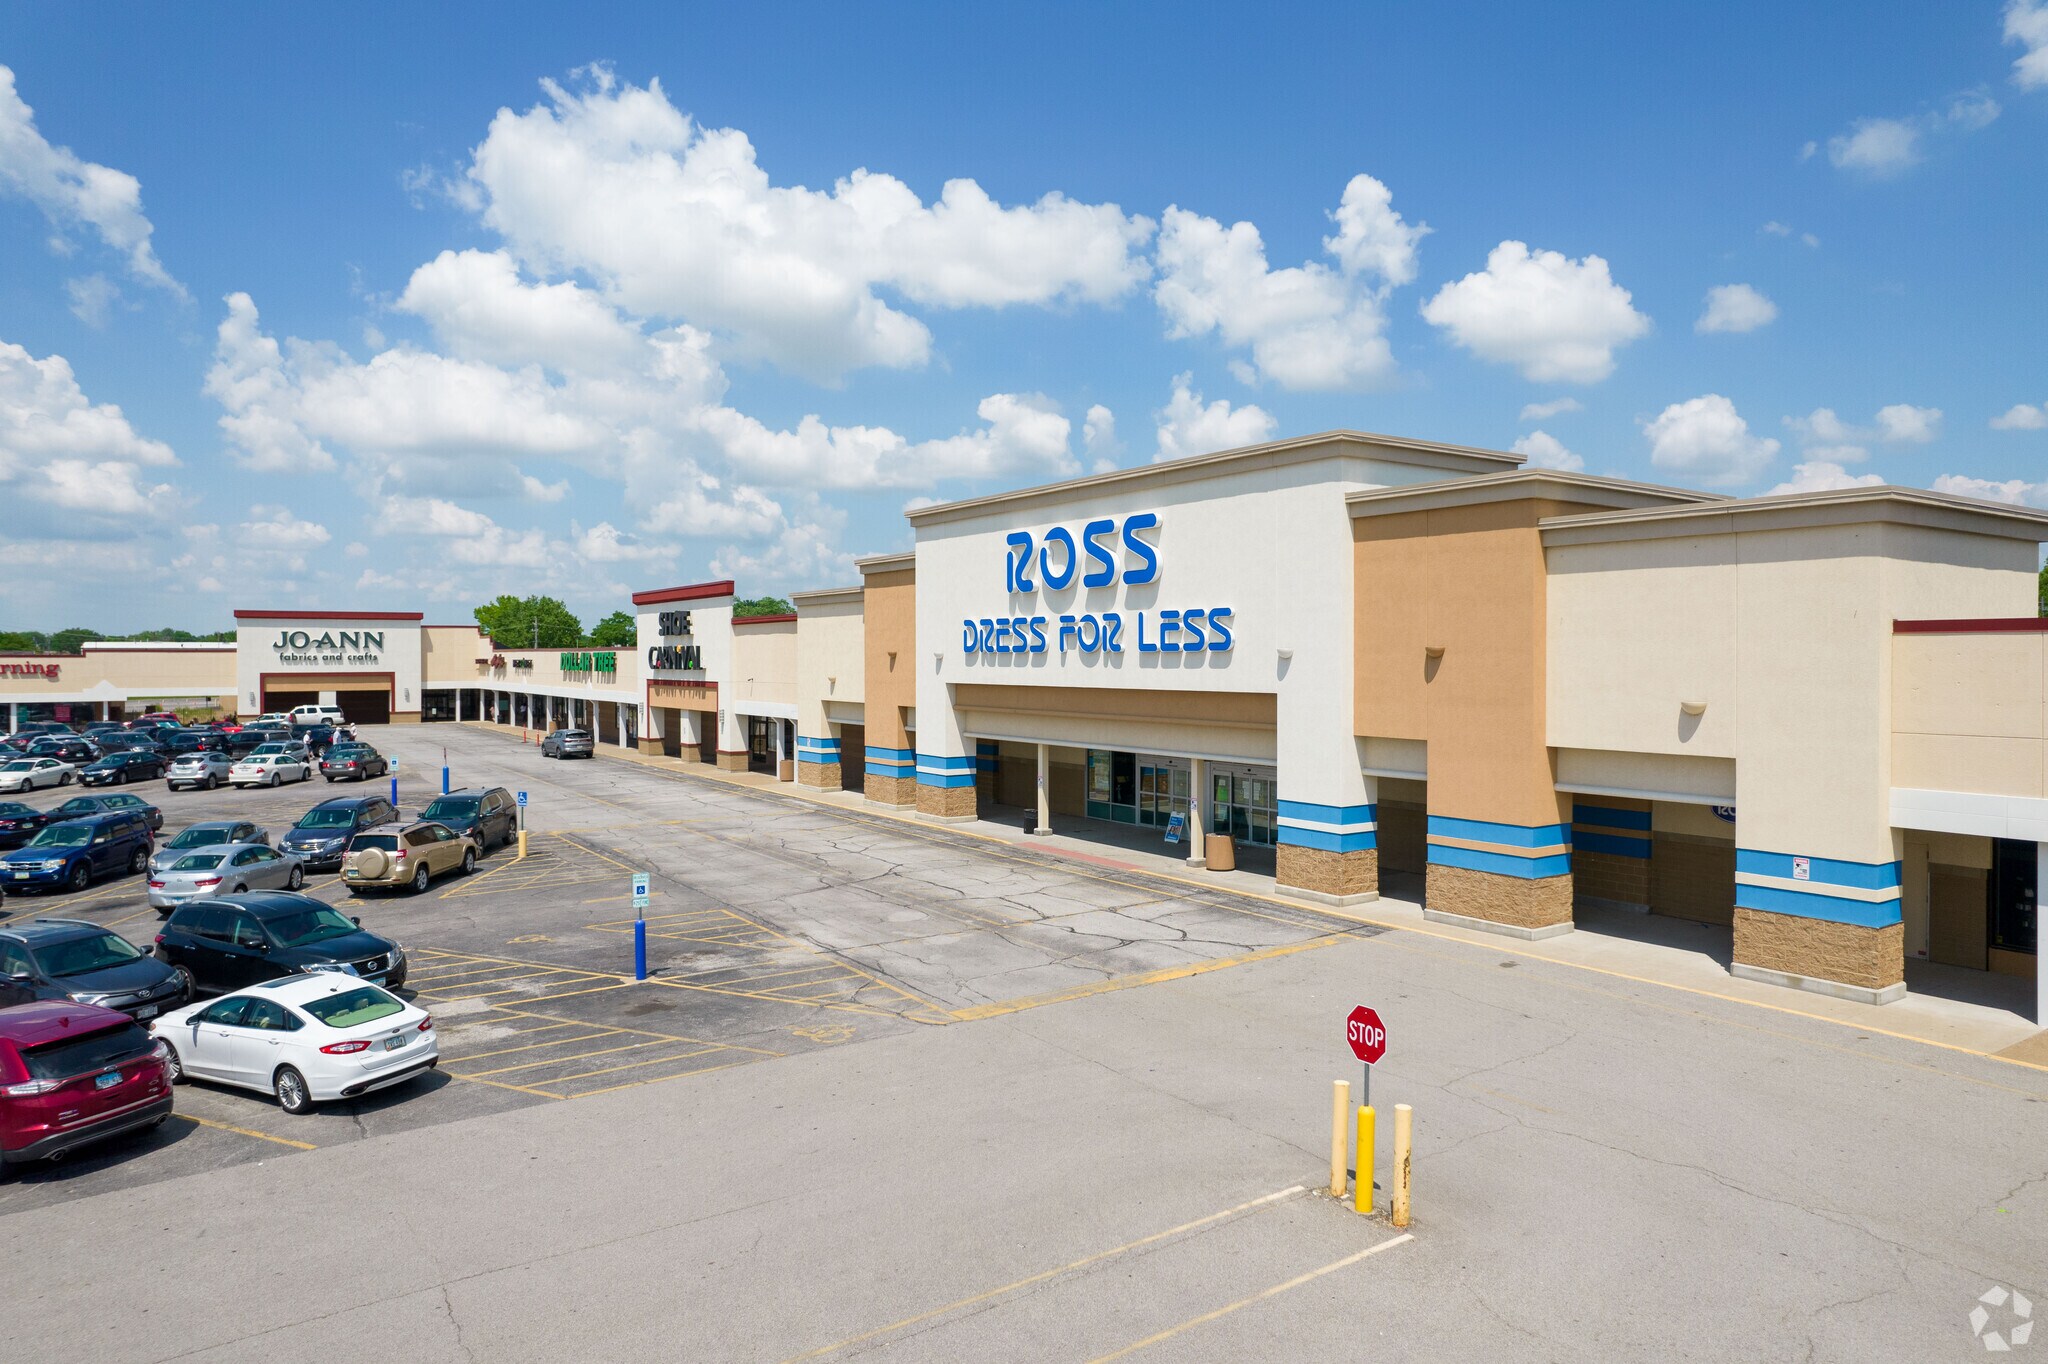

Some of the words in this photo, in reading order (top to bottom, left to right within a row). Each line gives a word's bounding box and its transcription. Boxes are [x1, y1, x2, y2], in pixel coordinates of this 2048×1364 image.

[1006, 513, 1160, 593] ROSS
[659, 611, 691, 636] SHOE
[963, 616, 1049, 653] DRESS
[1059, 613, 1124, 653] FOR
[1138, 607, 1234, 653] LESS
[280, 652, 318, 661] fabrics
[322, 652, 342, 661] and
[347, 652, 378, 661] crafts
[560, 652, 592, 671] DOLLAR
[593, 652, 616, 673] TREE
[648, 646, 703, 670] CARNIVAL
[1348, 1020, 1384, 1048] STOP
